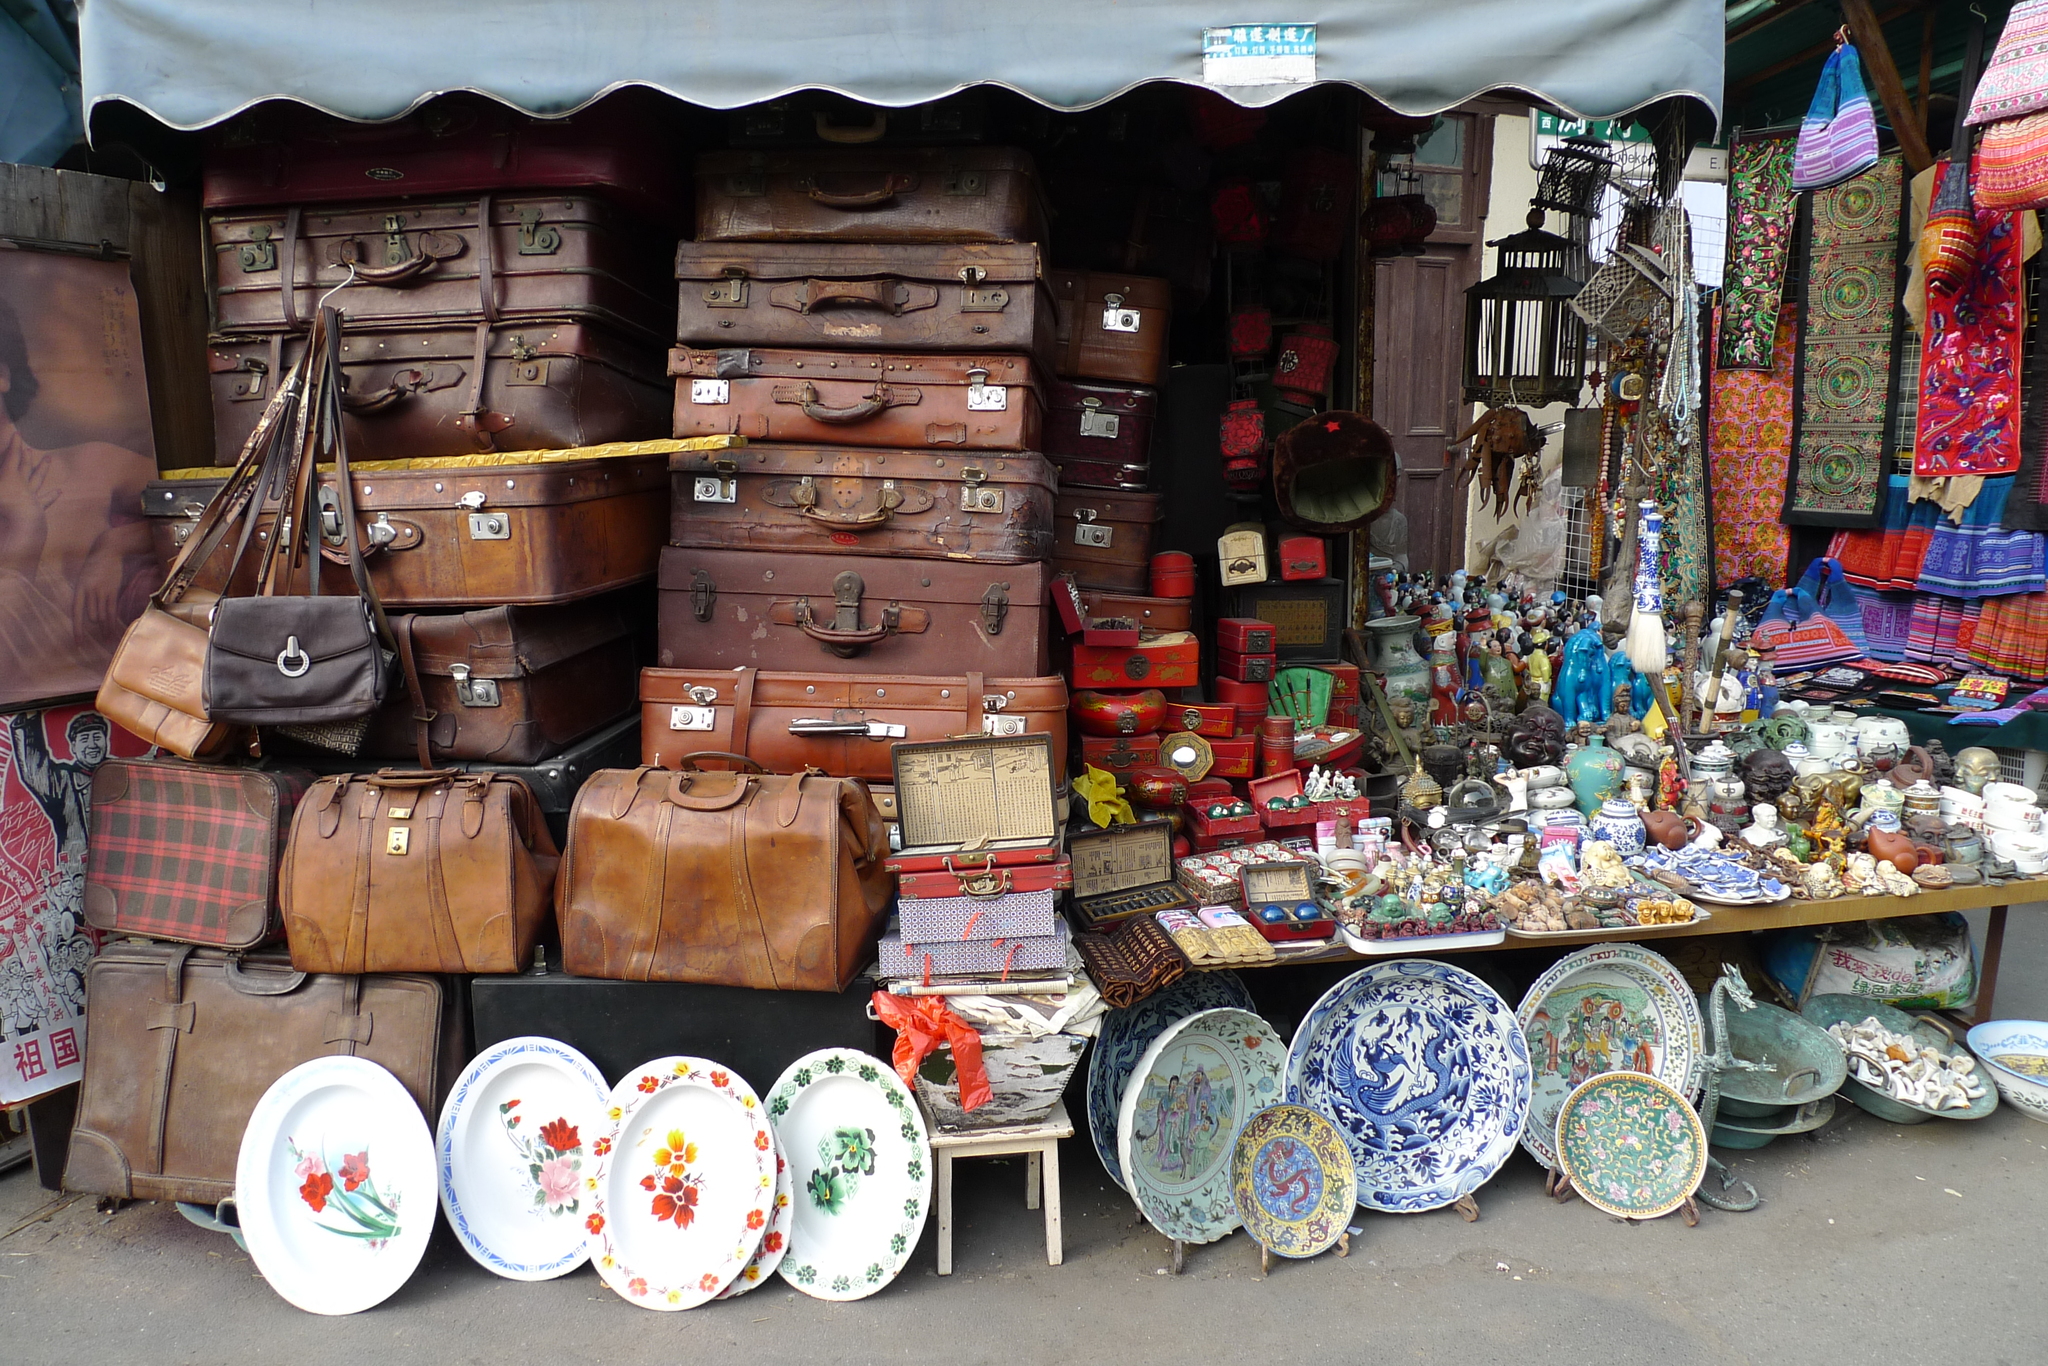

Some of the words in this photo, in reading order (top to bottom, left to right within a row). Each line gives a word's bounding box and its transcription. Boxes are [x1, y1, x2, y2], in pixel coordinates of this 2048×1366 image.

[1541, 116, 1552, 130] 西
[1710, 157, 1721, 170] E.
[13, 1027, 81, 1083] 祖国
